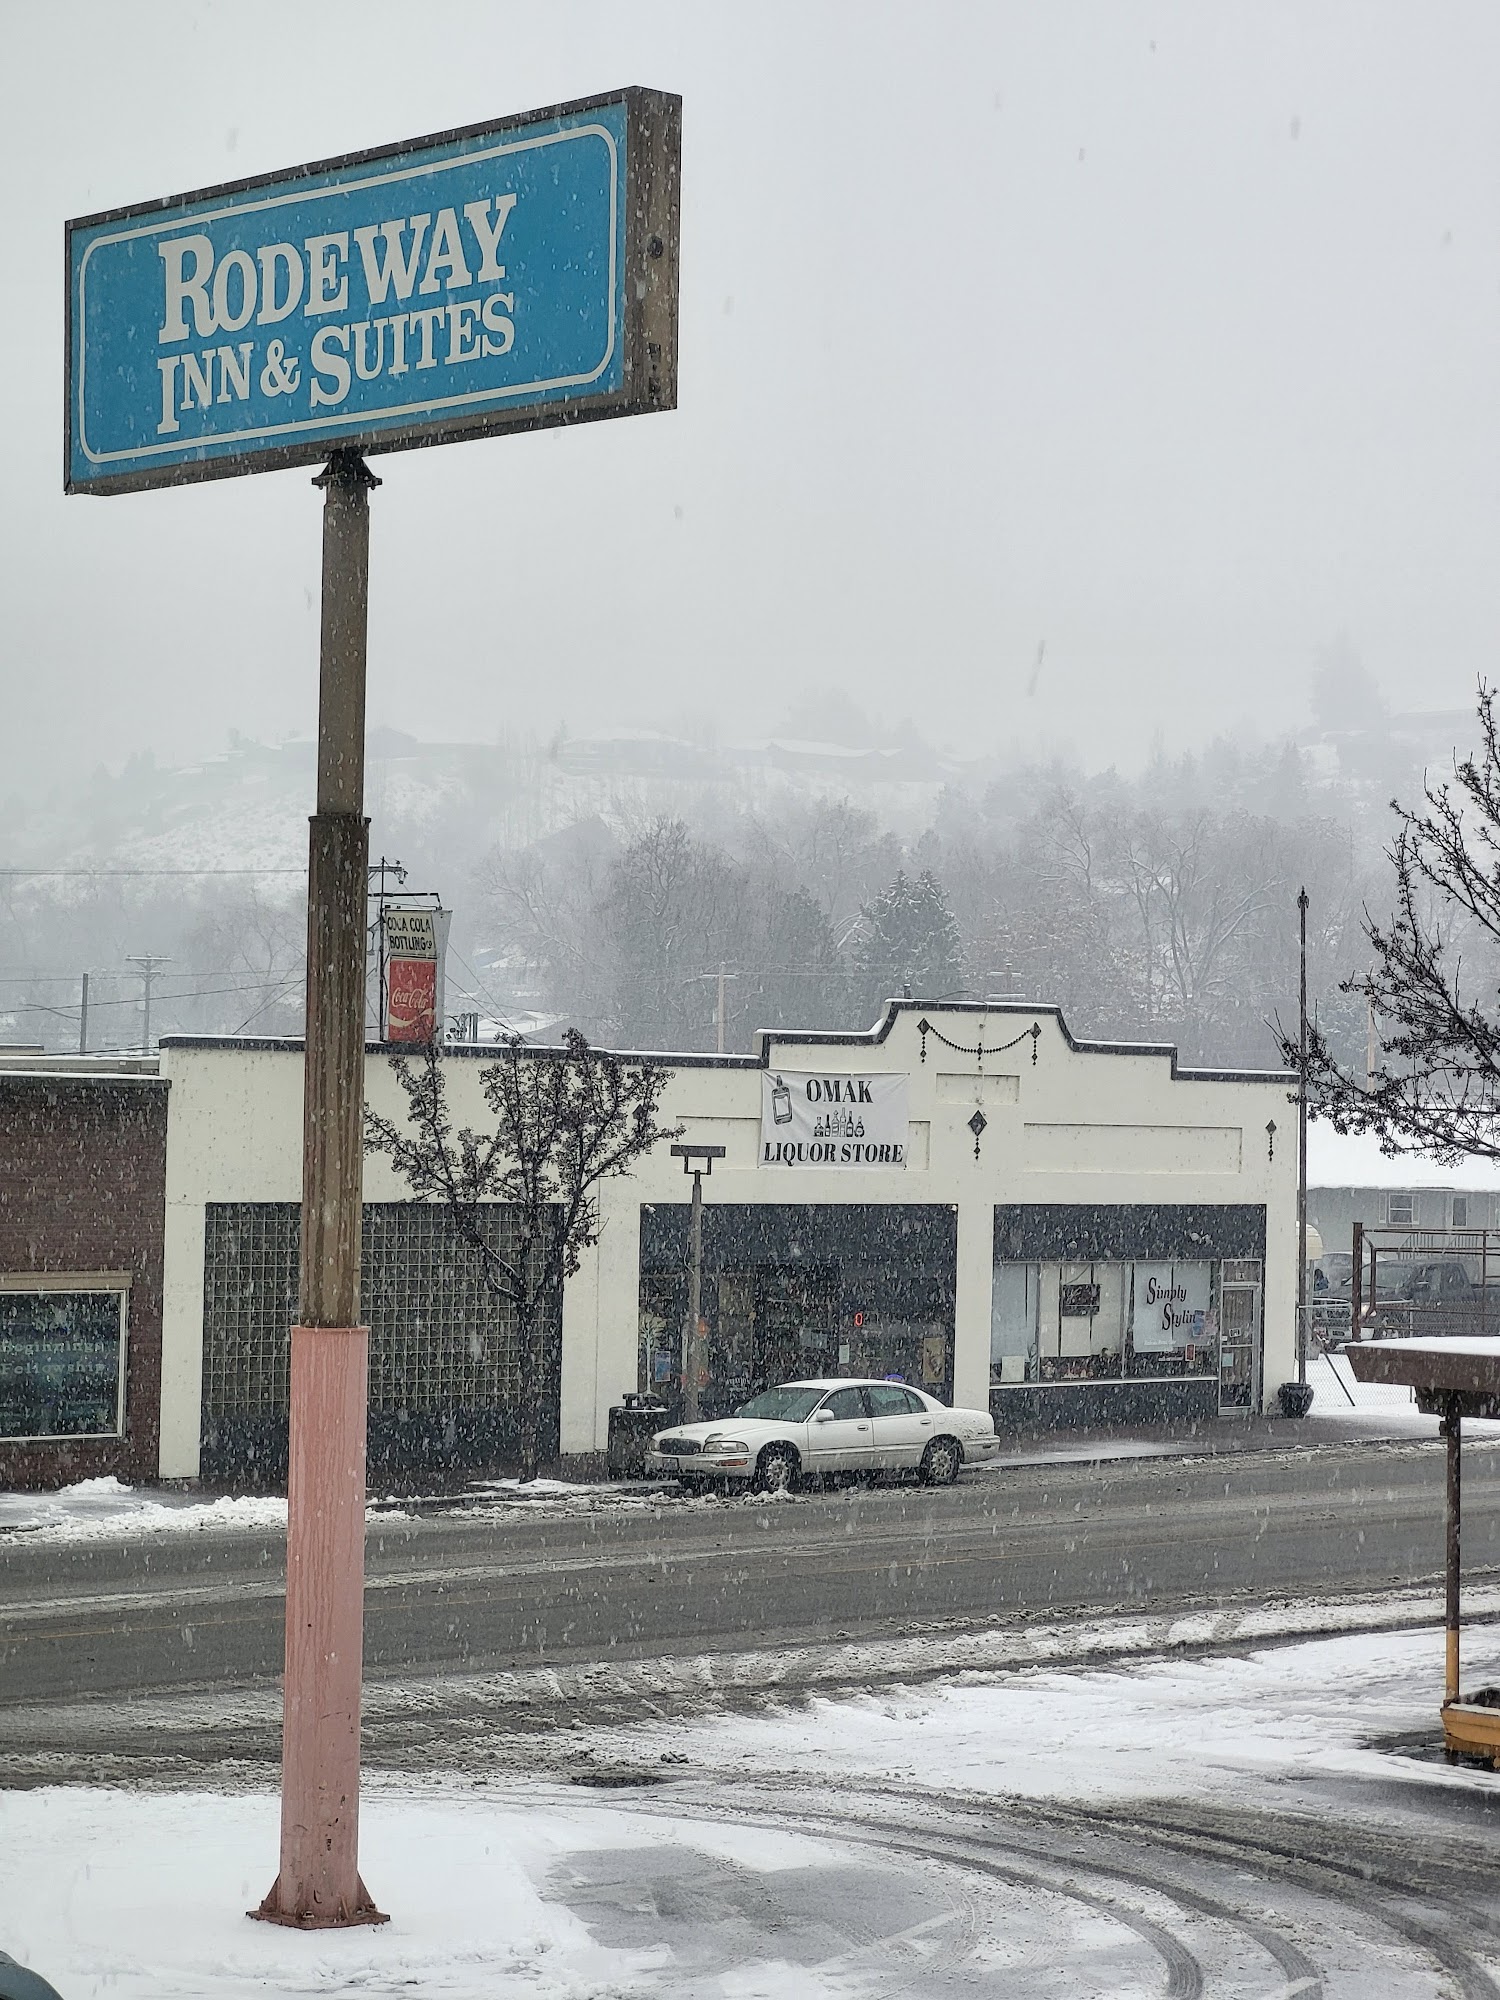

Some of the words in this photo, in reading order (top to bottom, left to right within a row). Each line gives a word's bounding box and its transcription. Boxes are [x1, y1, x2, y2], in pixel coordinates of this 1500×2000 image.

[159, 194, 517, 345] RODEWAY
[157, 341, 254, 435] INN
[260, 339, 302, 397] &
[310, 293, 516, 408] SUITES
[387, 916, 408, 932] COCA
[410, 917, 431, 933] COLA
[389, 935, 426, 951] BOTTLING
[806, 1079, 874, 1104] OMAK
[764, 1142, 836, 1167] LIQUOR
[841, 1143, 904, 1163] STORE
[1146, 1277, 1187, 1305] Simply
[0, 1361, 106, 1375] Fellowship
